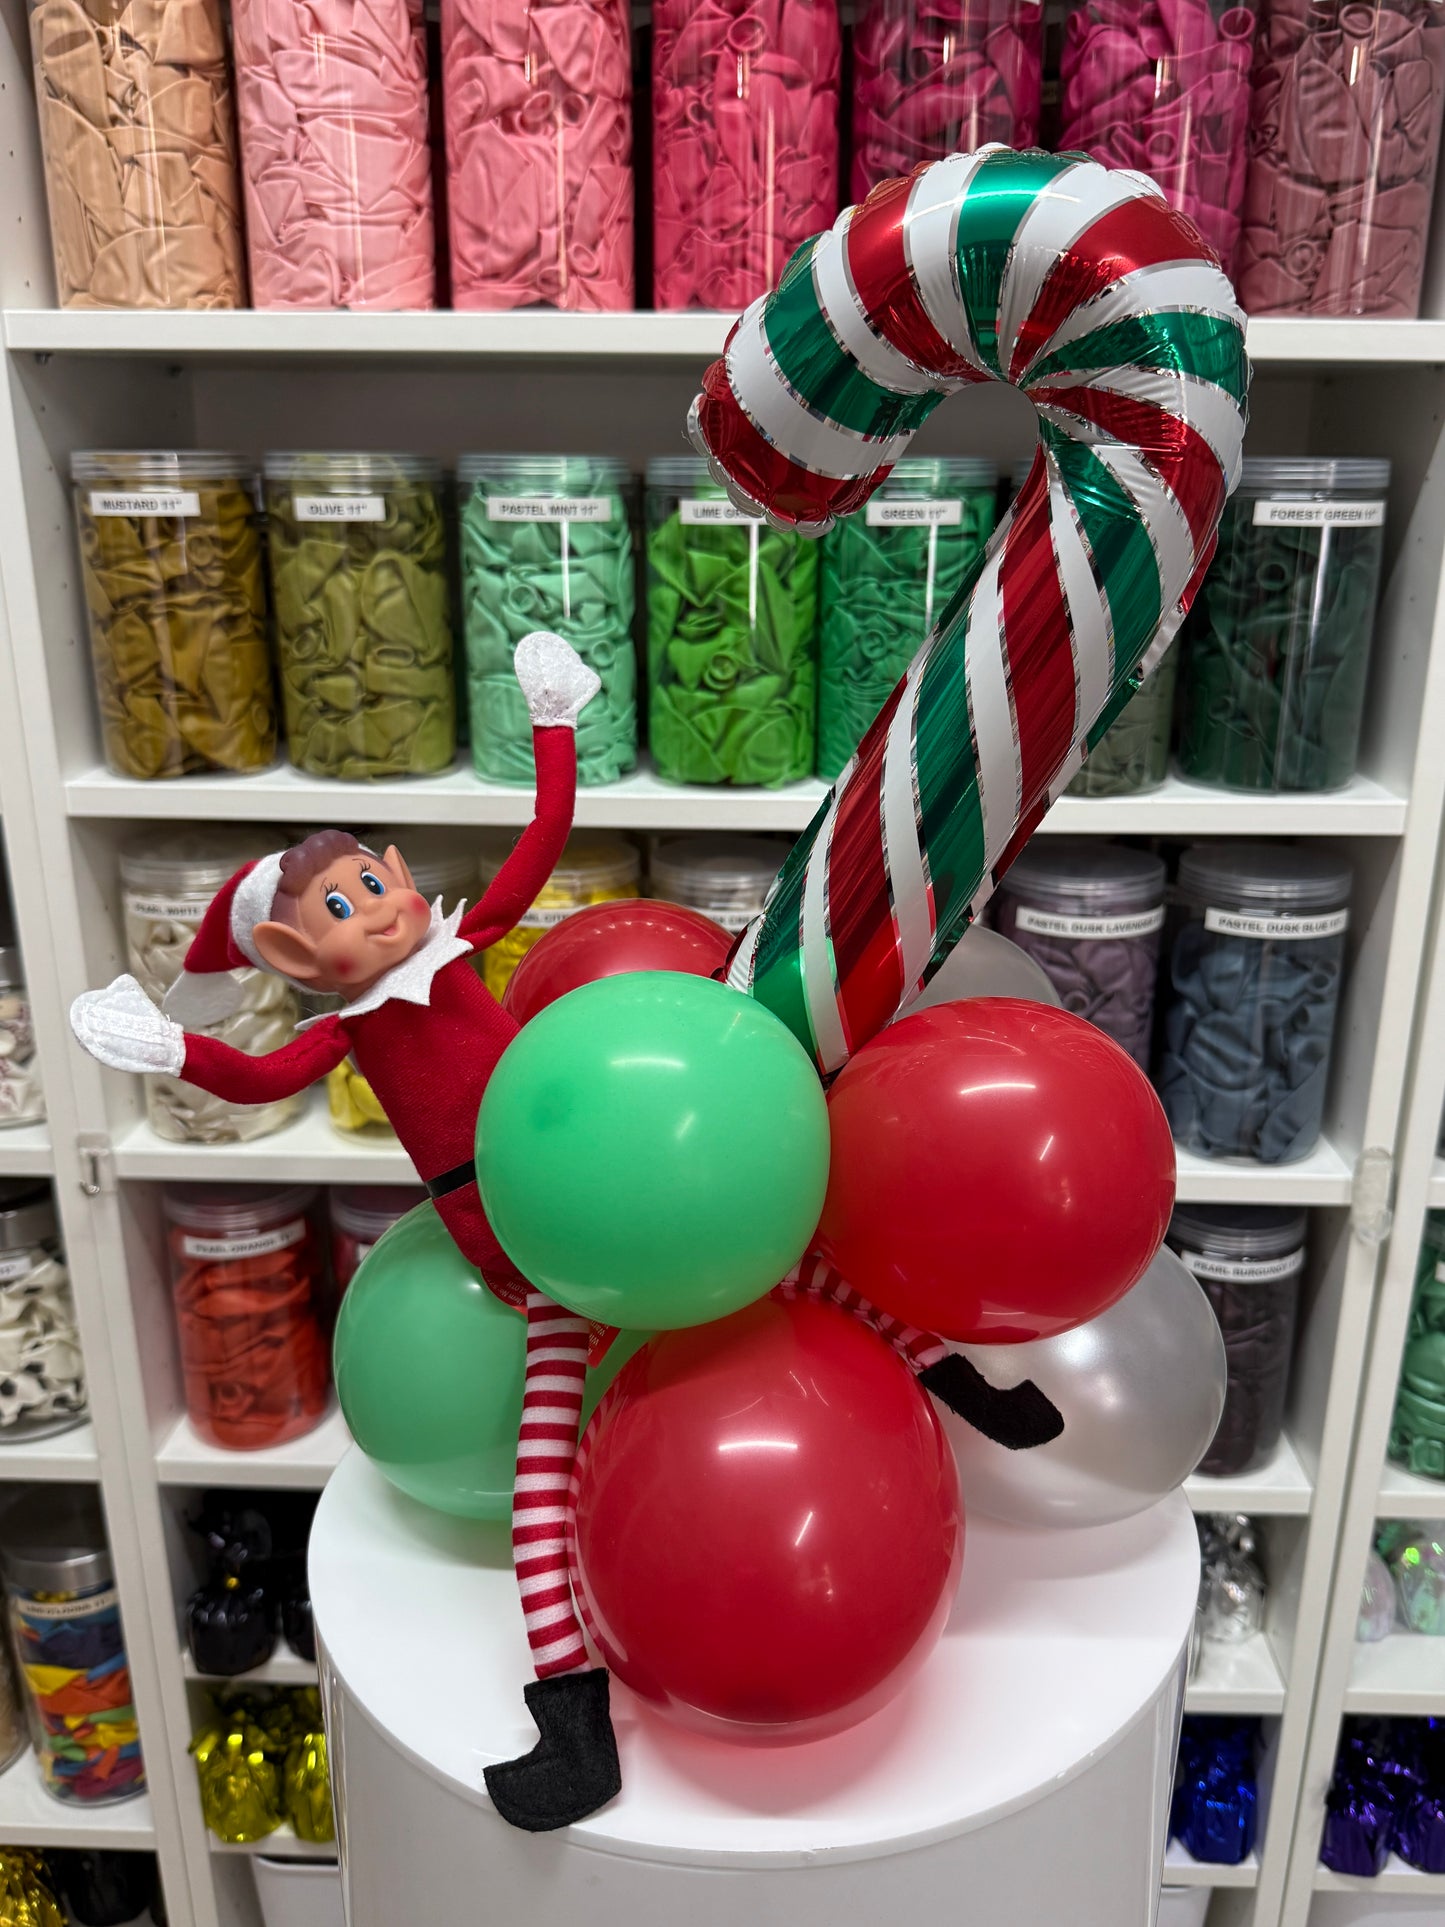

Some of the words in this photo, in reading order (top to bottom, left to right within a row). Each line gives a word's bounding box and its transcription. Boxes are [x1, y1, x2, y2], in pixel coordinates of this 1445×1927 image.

[102, 500, 159, 511] MUSTARD
[308, 504, 345, 516] OLIVE
[501, 504, 546, 516] PASTEL
[549, 504, 577, 516] MINT
[692, 507, 722, 519] LIME
[881, 508, 925, 520] GREEN
[1270, 508, 1321, 521] FOREST
[1323, 508, 1363, 521] GREEN
[1027, 915, 1067, 932] PASTEL
[1070, 922, 1102, 934] DUSK
[1218, 915, 1263, 932] PASTEL
[1266, 922, 1300, 934] DUSK
[1302, 920, 1328, 933] BLUE
